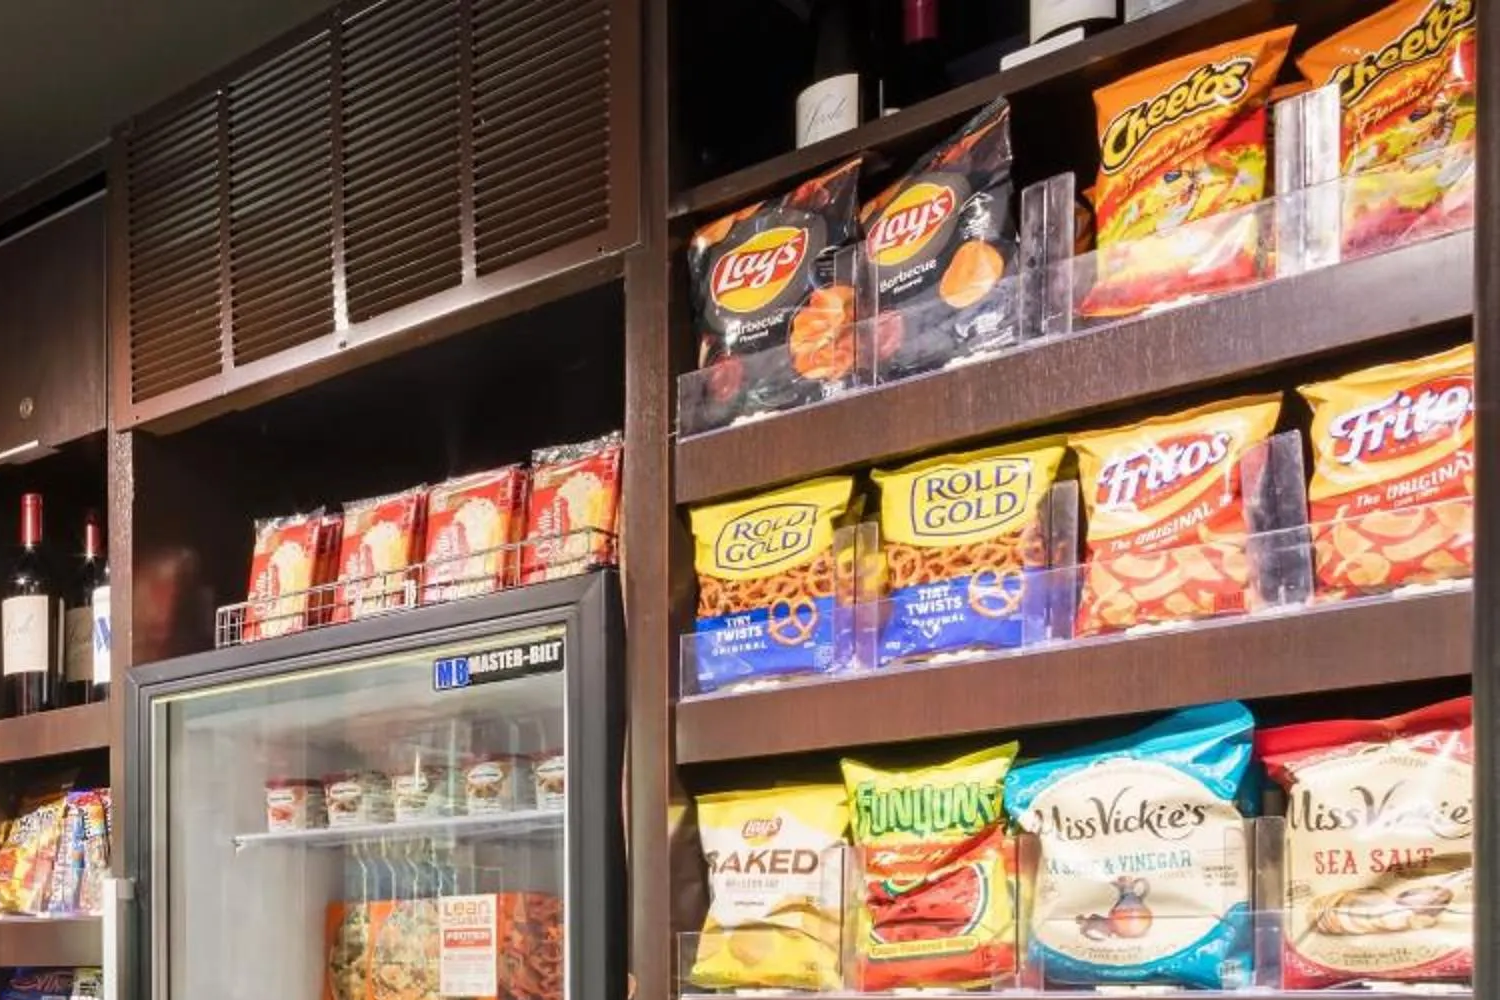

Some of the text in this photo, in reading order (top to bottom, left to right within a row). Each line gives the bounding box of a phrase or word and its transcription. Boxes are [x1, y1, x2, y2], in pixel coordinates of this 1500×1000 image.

[1101, 59, 1252, 172] Cheetos
[1329, 385, 1474, 465] Frito
[926, 463, 1022, 501] ROLD
[1097, 431, 1231, 513] Fritos
[1386, 450, 1473, 501] ORIGINA
[734, 512, 805, 540] ROLD
[924, 490, 1018, 528] GOLD
[725, 531, 802, 563] GOLD
[904, 596, 963, 616] TWISTS
[715, 626, 763, 643] TWISTS
[468, 641, 562, 675] MASTER-BILT
[856, 780, 1003, 839] FUNYUNS
[1089, 786, 1207, 841] Vickie's
[1118, 850, 1193, 873] VINEGAR
[1314, 847, 1435, 876] SEA SALT
